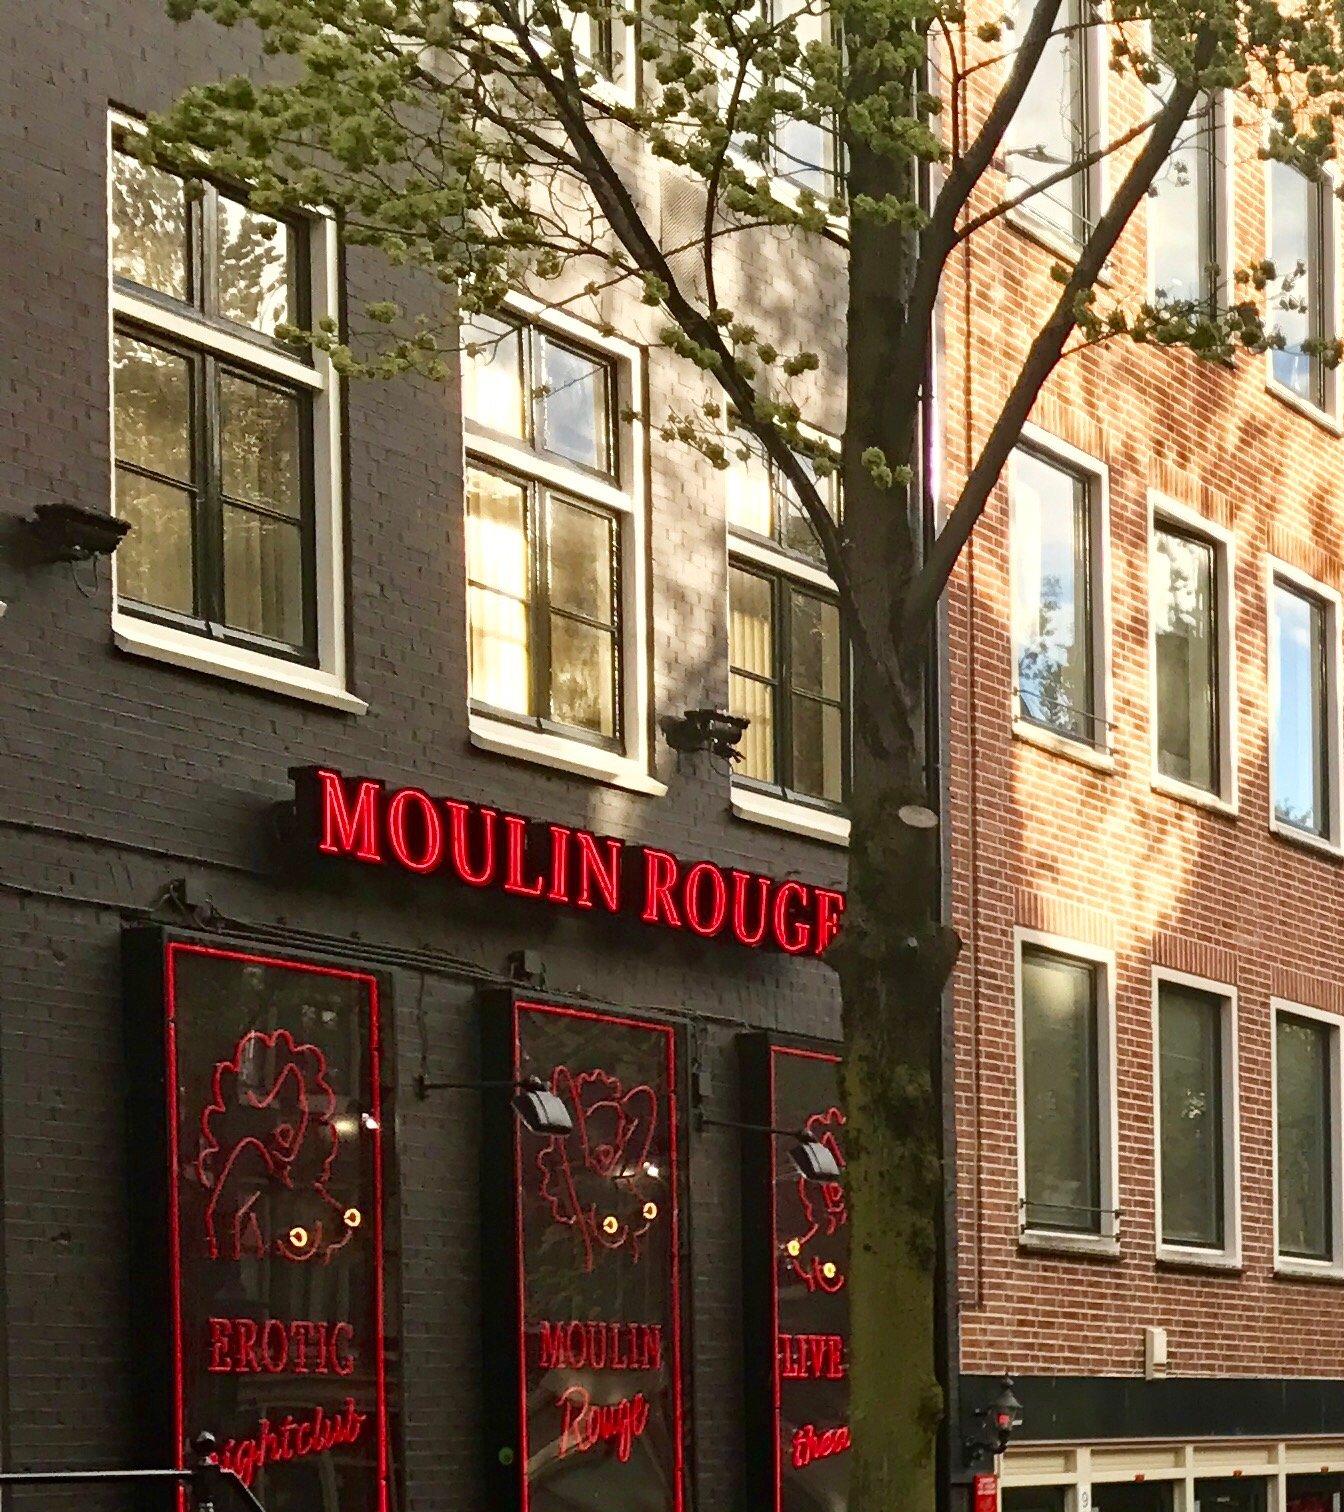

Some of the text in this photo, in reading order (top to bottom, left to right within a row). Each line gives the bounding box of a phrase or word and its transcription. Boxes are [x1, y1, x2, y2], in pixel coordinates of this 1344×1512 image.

[316, 768, 623, 915] MOULIN
[207, 1316, 355, 1377] EROTIC
[539, 1320, 662, 1370] MOULIN
[778, 1333, 845, 1379] LIVE
[554, 1384, 650, 1463] Rouge
